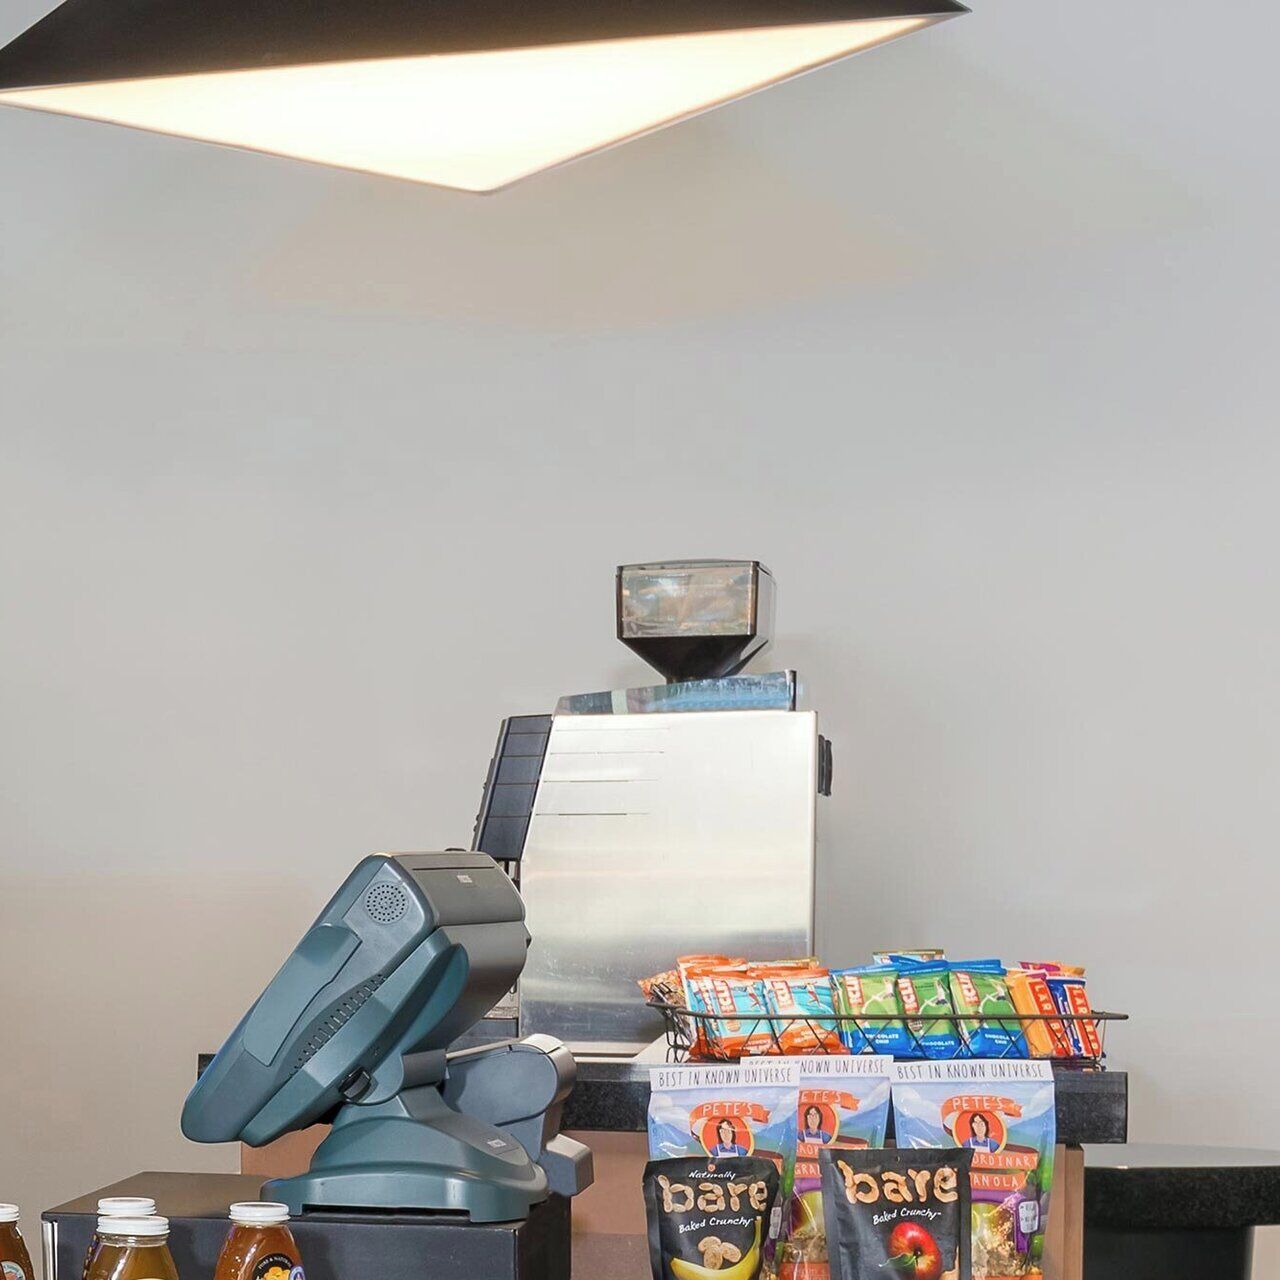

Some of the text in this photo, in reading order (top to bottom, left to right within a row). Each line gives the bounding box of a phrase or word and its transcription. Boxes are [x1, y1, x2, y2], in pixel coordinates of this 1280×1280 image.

[836, 1058, 885, 1074] UNIVERSE
[897, 1062, 1044, 1080] BEST IN KNOWN UNIVERSE
[659, 1066, 791, 1087] BEST IN KNOWN UNIVERSE
[702, 1103, 753, 1116] PETE'S
[952, 1097, 1003, 1110] PETE'S
[689, 1169, 736, 1181] Naturally
[837, 1159, 959, 1204] bare
[658, 1174, 768, 1213] bare
[873, 1207, 939, 1226] Baked Crunchy
[679, 1217, 751, 1234] Baked Crunchy
